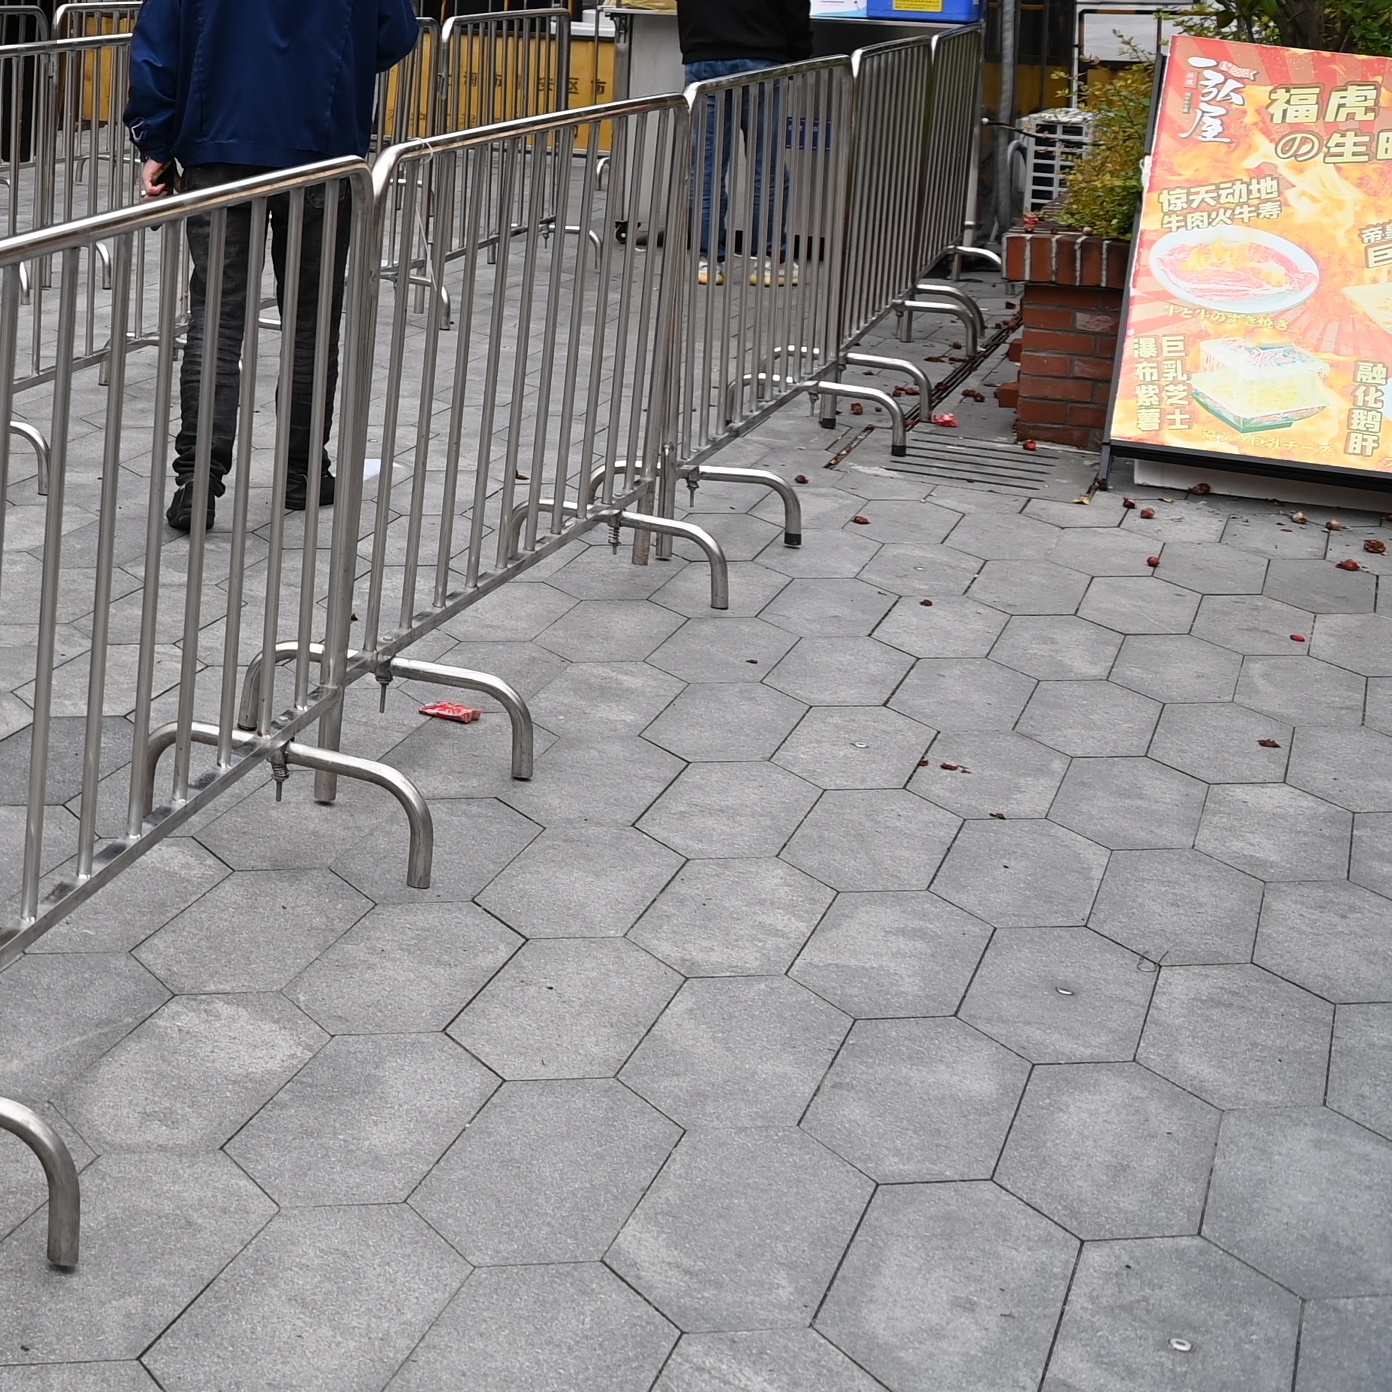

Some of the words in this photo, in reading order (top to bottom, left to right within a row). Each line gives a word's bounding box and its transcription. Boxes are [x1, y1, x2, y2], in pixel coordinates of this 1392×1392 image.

[1268, 84, 1378, 124] 福虎
[1159, 176, 1279, 213] 惊天动地
[1162, 201, 1282, 232] 牛肉火牛寿
[1162, 335, 1191, 430] 巨乳芝士
[1347, 361, 1387, 457] 融化鹅肝
